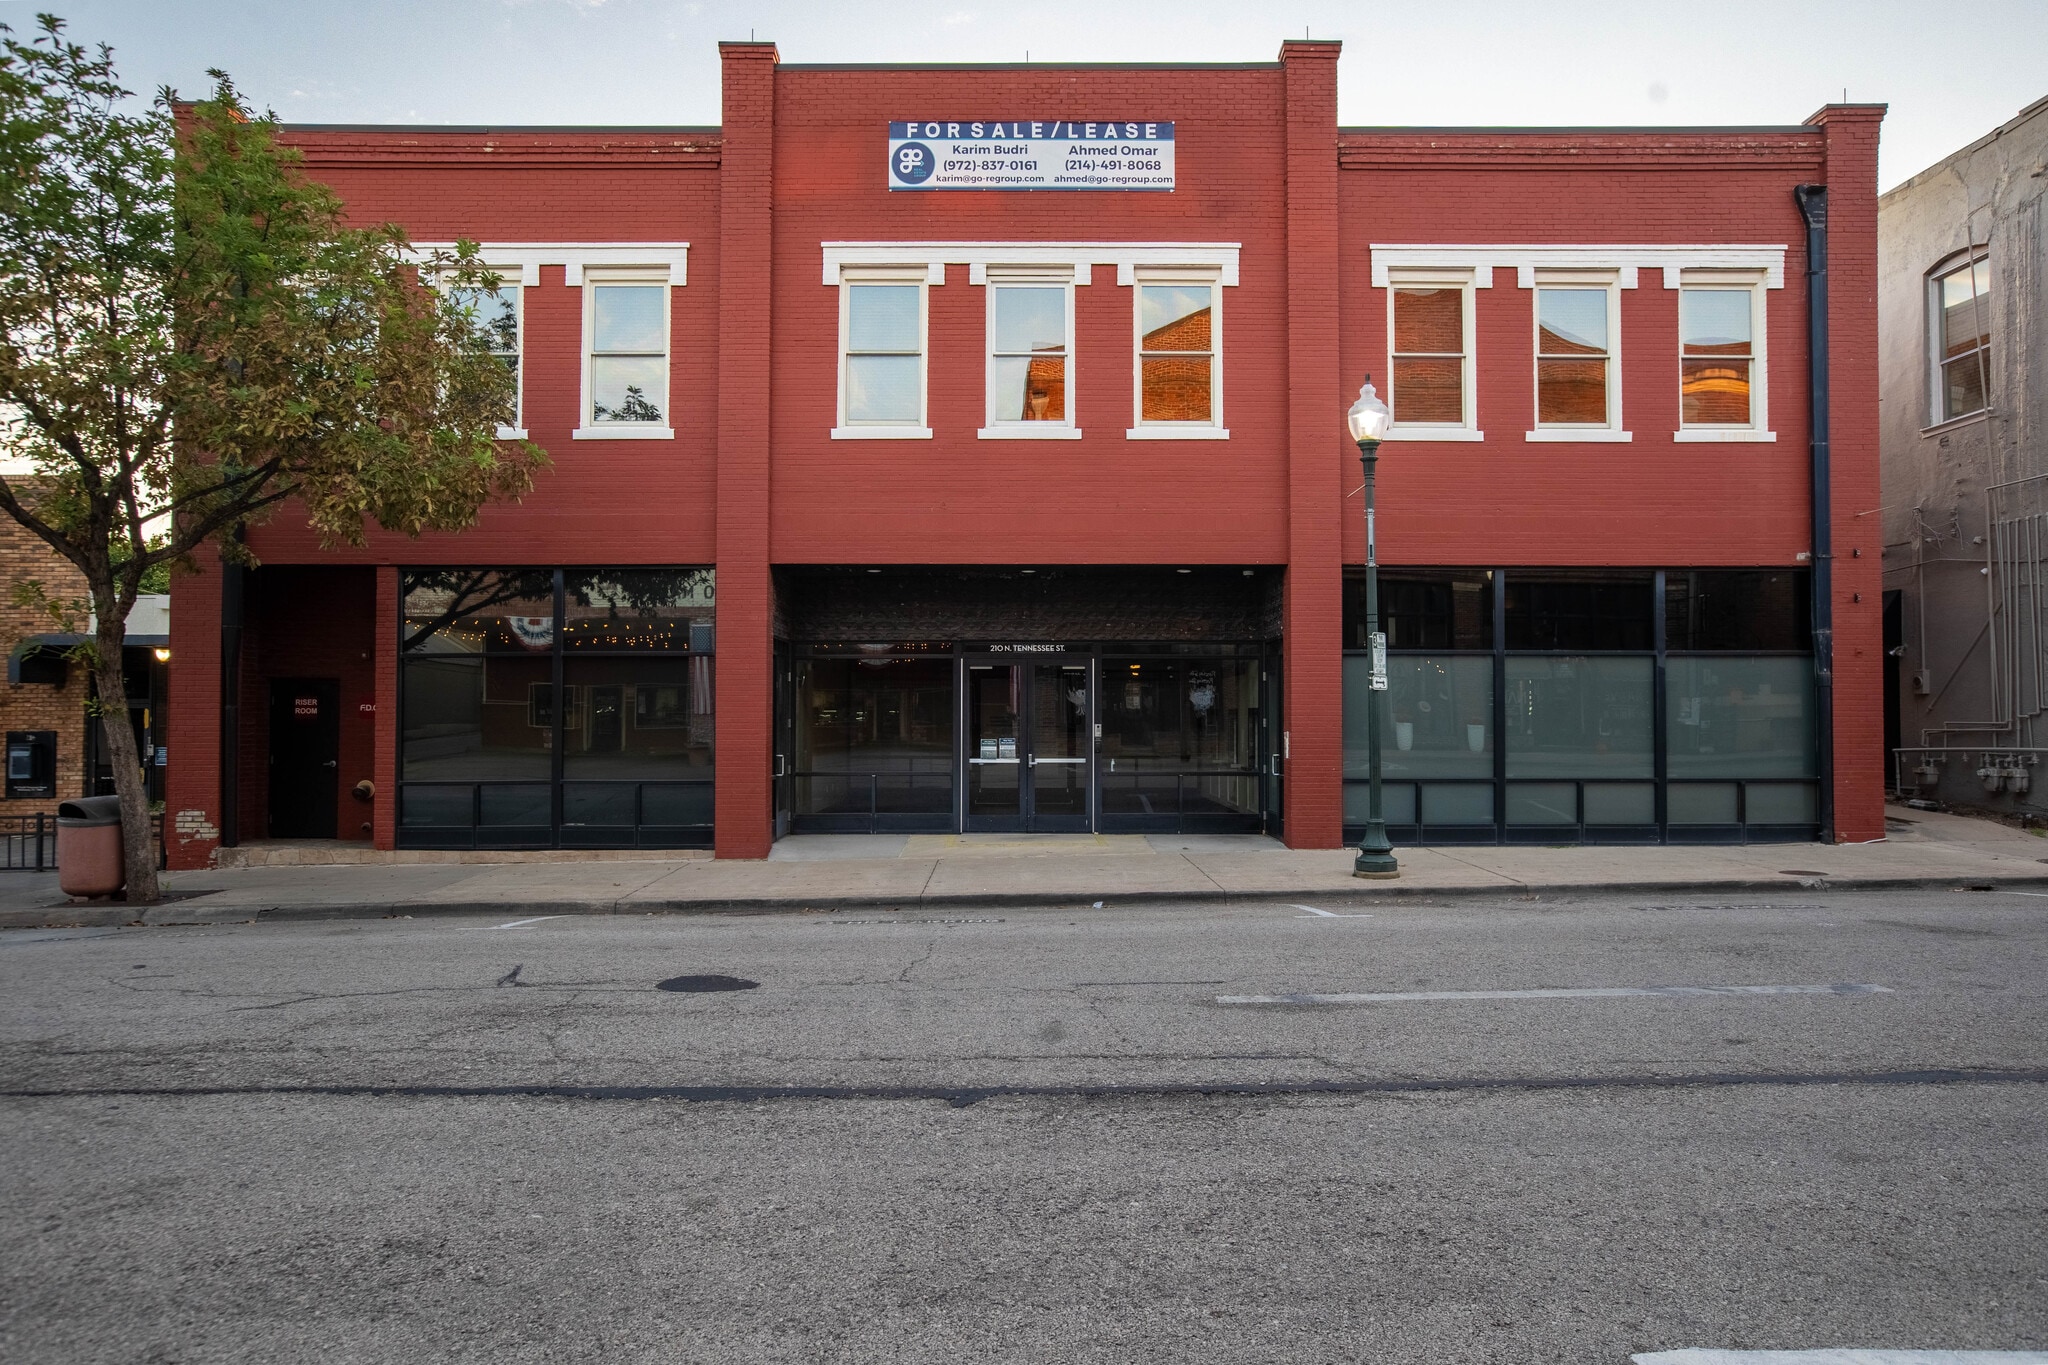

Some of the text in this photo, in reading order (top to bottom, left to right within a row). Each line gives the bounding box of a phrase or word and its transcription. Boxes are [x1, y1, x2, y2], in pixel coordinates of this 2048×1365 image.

[907, 121, 1157, 139] FOR SALE/LEASE
[952, 144, 1028, 155] Karim Budri
[1068, 145, 1159, 156] Ahmed Omar
[943, 159, 1038, 172] (972)-837-0161
[1065, 159, 1162, 172] (214)-491-8068
[936, 175, 1045, 183] karim@go-regroup.com
[1054, 175, 1173, 184] ahmed@go-regroup.com
[990, 644, 1066, 652] 210 N. TENNESSEE ST.
[295, 707, 318, 715] ROOM
